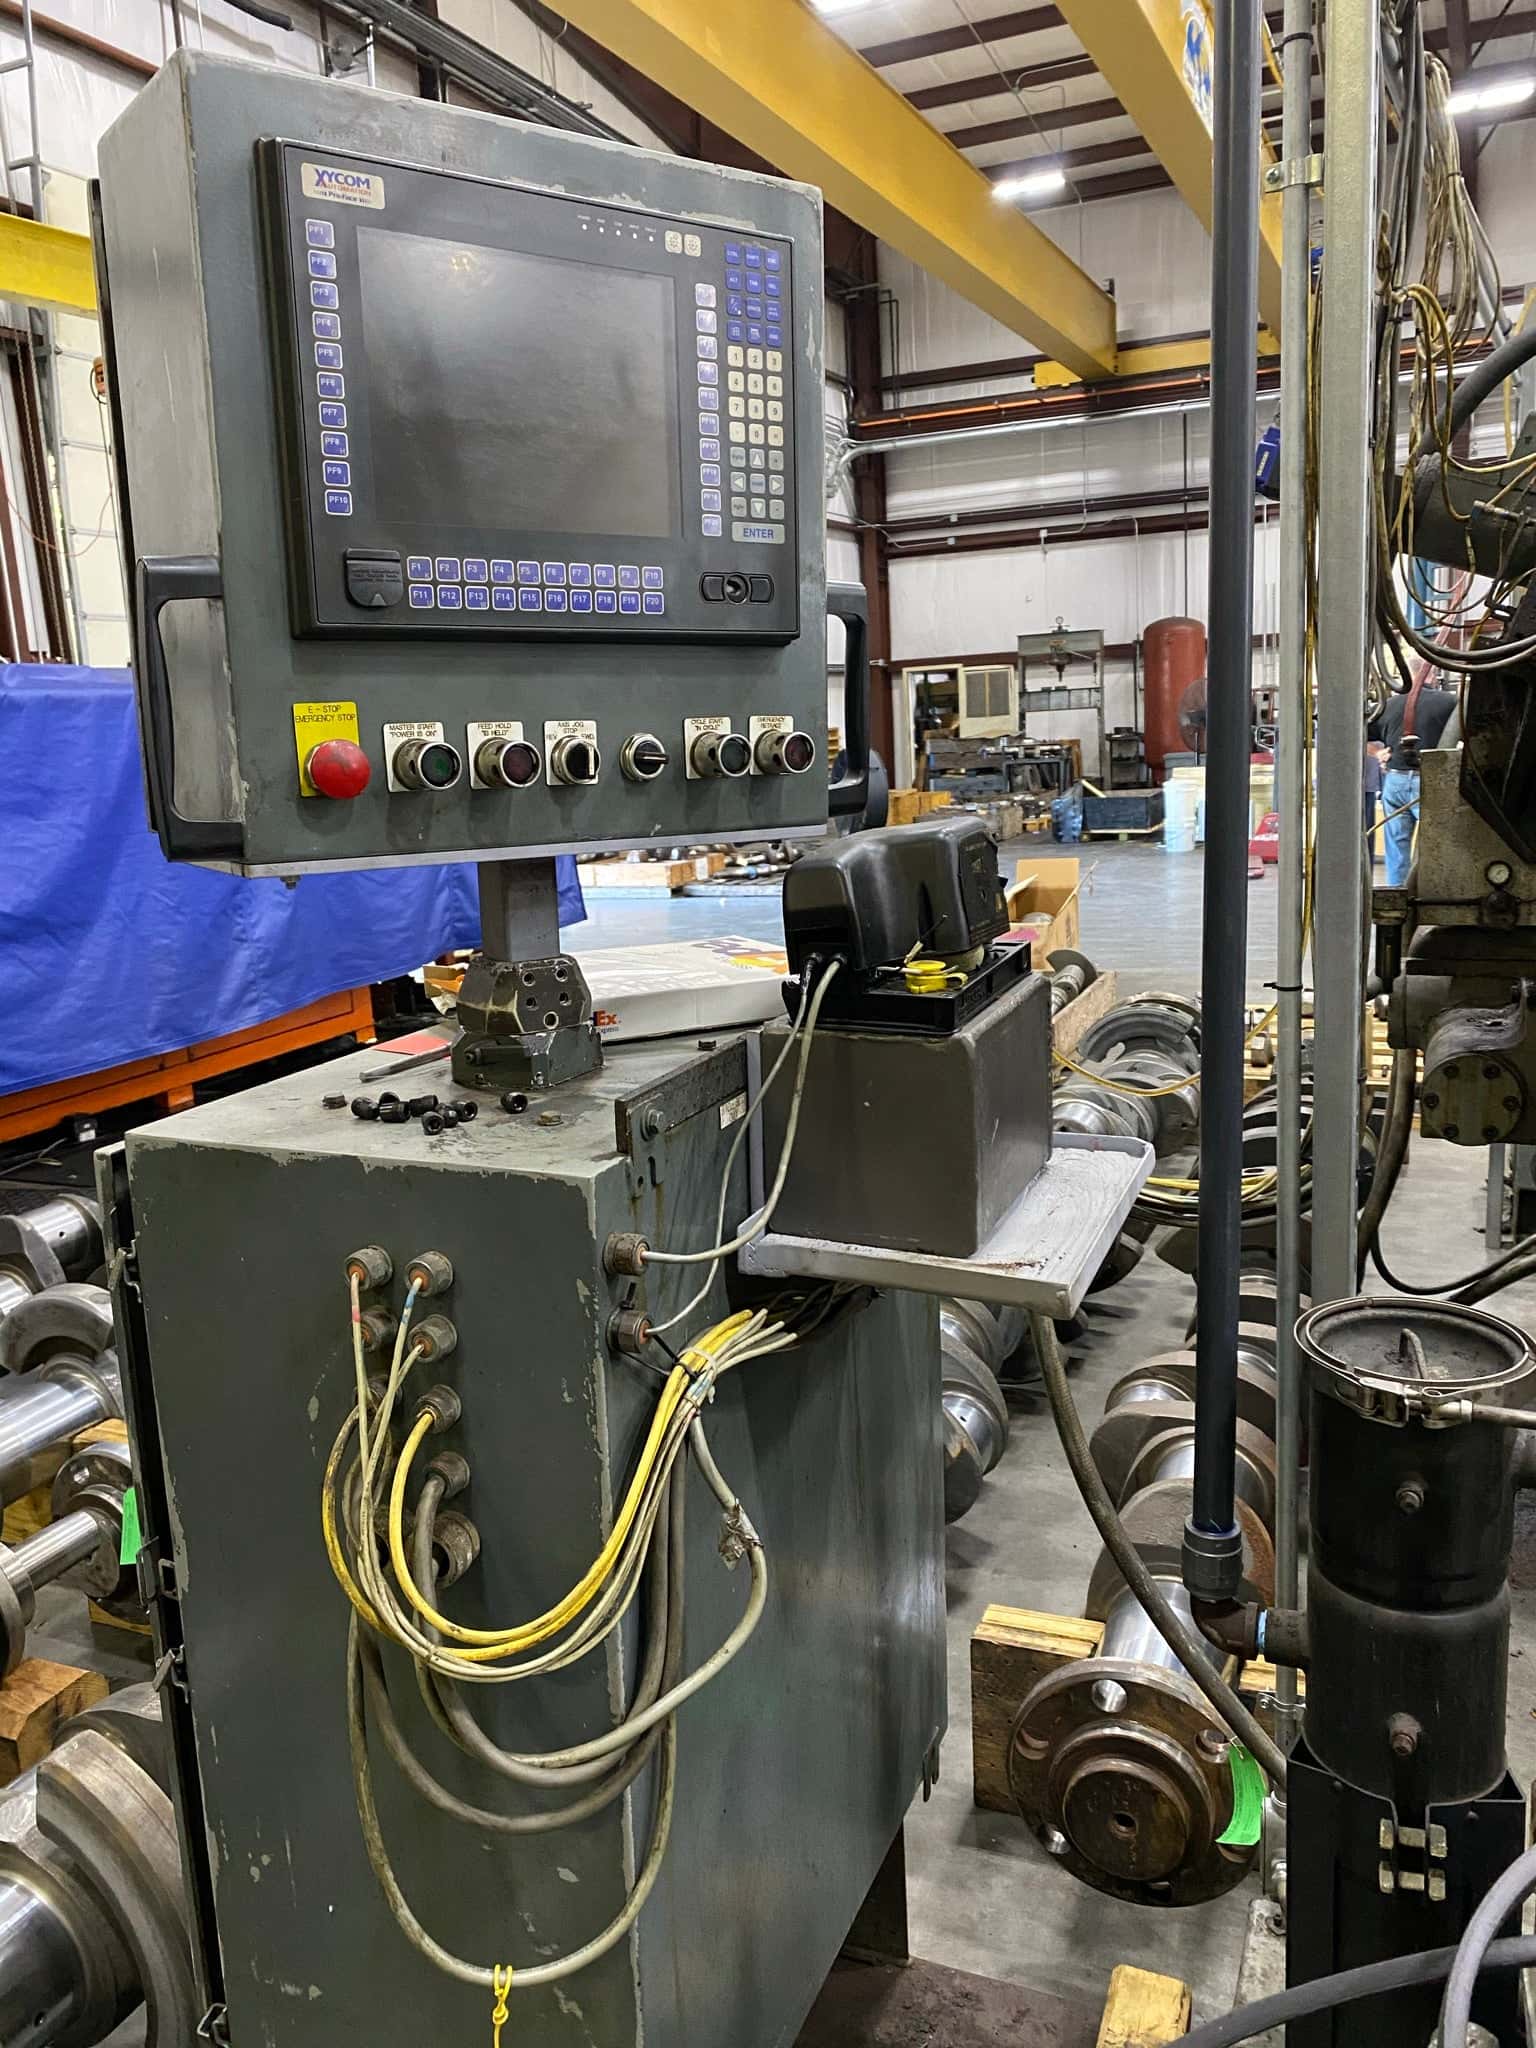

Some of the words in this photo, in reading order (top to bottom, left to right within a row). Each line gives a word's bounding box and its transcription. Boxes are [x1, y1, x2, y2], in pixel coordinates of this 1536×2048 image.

[314, 168, 371, 190] XYCOM
[308, 225, 324, 235] PF1
[311, 256, 328, 266] PF2
[313, 287, 329, 296] PF3
[315, 317, 331, 326] PF4
[318, 347, 334, 357] PF5
[322, 408, 337, 416] PF7
[328, 495, 349, 504] PF10
[743, 527, 774, 539] ENTER
[411, 562, 421, 571] F1
[440, 564, 450, 573] F2
[467, 565, 478, 573] F3
[494, 565, 505, 575] F4
[521, 567, 531, 575] F5
[572, 569, 582, 577] F7
[645, 571, 659, 580] F10
[413, 590, 428, 599] F11
[441, 591, 457, 600] F12
[468, 592, 484, 601] F13
[496, 593, 511, 601] F14
[522, 594, 537, 602] F15
[548, 594, 562, 603] F16
[573, 594, 588, 603] F17
[646, 597, 660, 605] F20
[308, 705, 313, 714] E
[322, 704, 342, 713] STOP
[295, 714, 335, 723] EMERGENCY
[338, 713, 356, 721] STOP
[389, 723, 415, 731] MASTER
